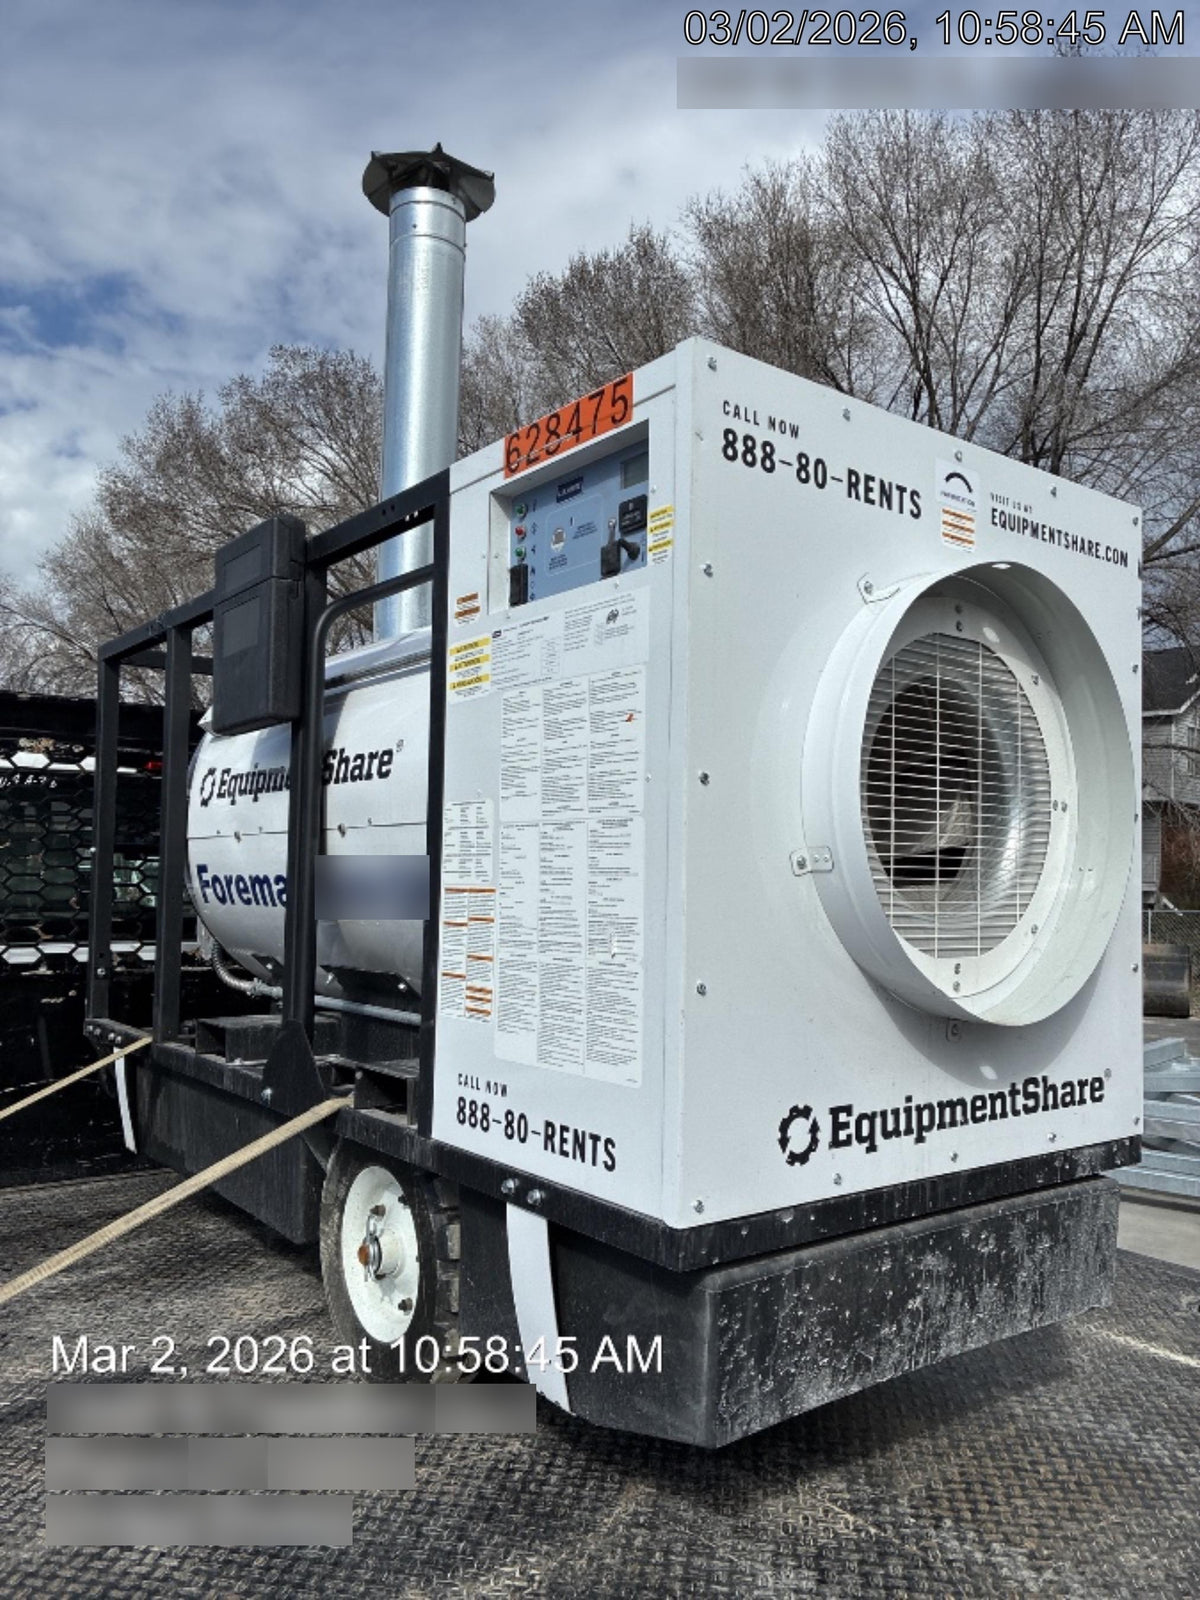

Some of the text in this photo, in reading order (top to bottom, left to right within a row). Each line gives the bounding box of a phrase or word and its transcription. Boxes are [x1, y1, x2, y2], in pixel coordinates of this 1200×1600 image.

[506, 378, 629, 474] 628475
[722, 400, 800, 439] CALL NOW
[721, 428, 922, 520] 888-80-RENTS
[457, 1073, 481, 1091] CALL
[828, 1075, 1105, 1154] EquipmentShare
[456, 1096, 616, 1173] 888-80-RENTS
